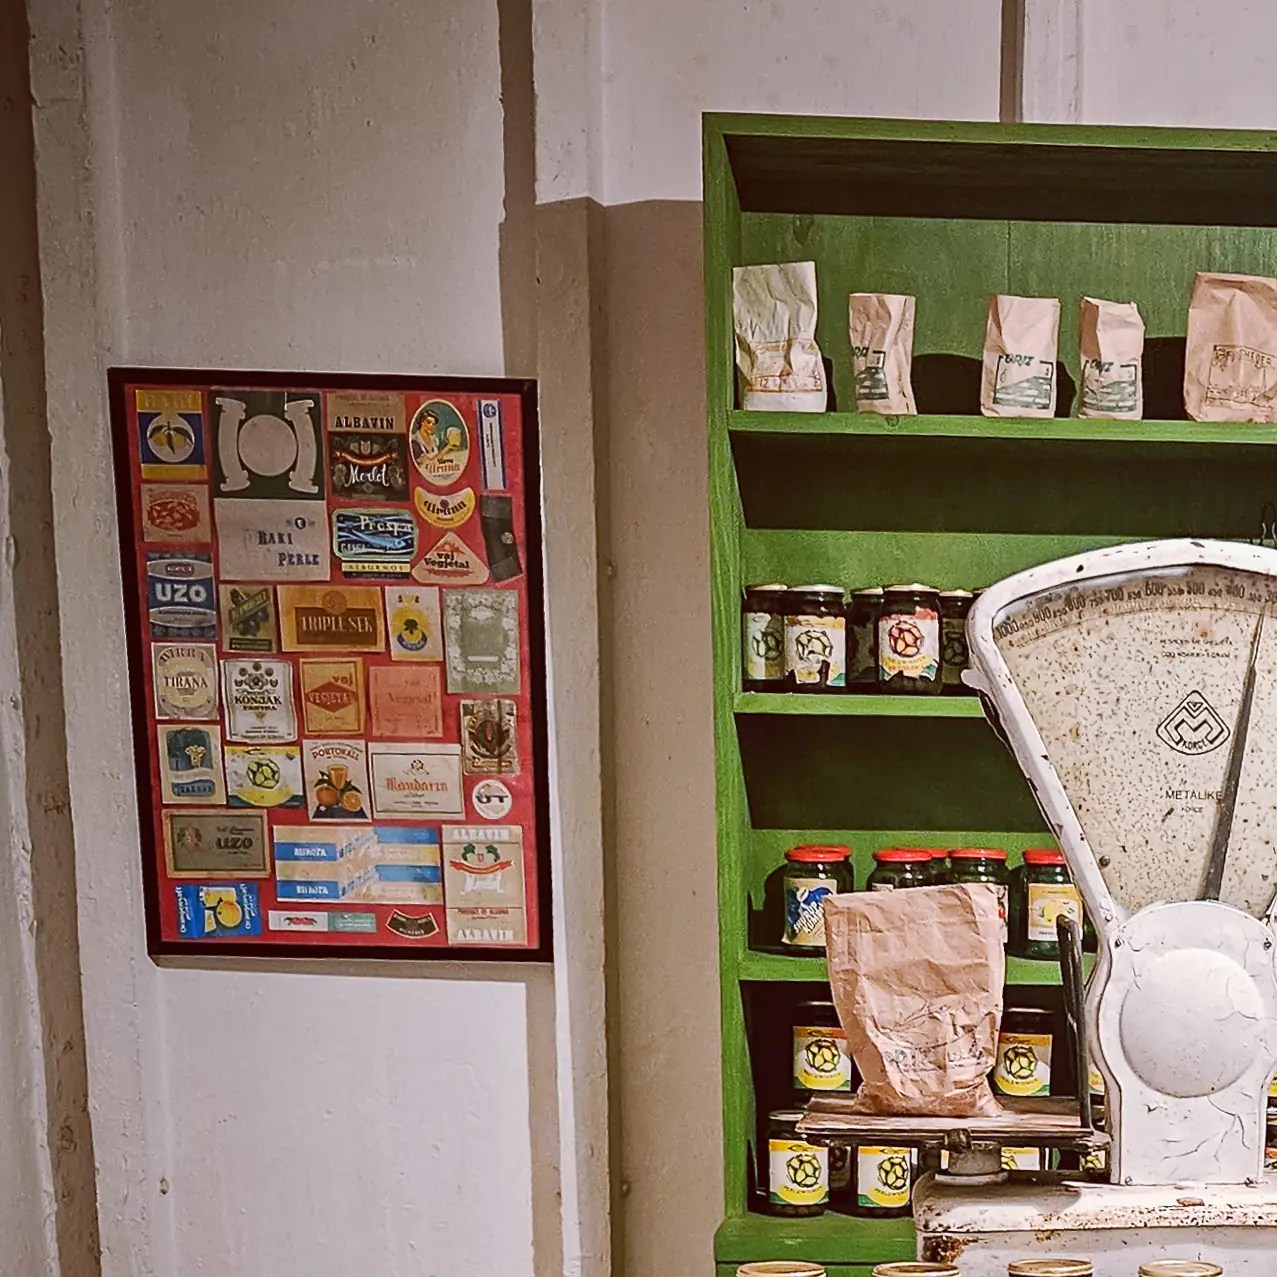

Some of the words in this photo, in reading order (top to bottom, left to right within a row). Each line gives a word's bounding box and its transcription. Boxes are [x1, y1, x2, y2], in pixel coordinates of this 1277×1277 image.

[335, 416, 394, 430] ALBAVIN
[155, 583, 207, 603] UZO
[164, 676, 208, 689] TIRANA
[234, 696, 282, 705] KONJAK
[1165, 789, 1223, 801] METALIKE
